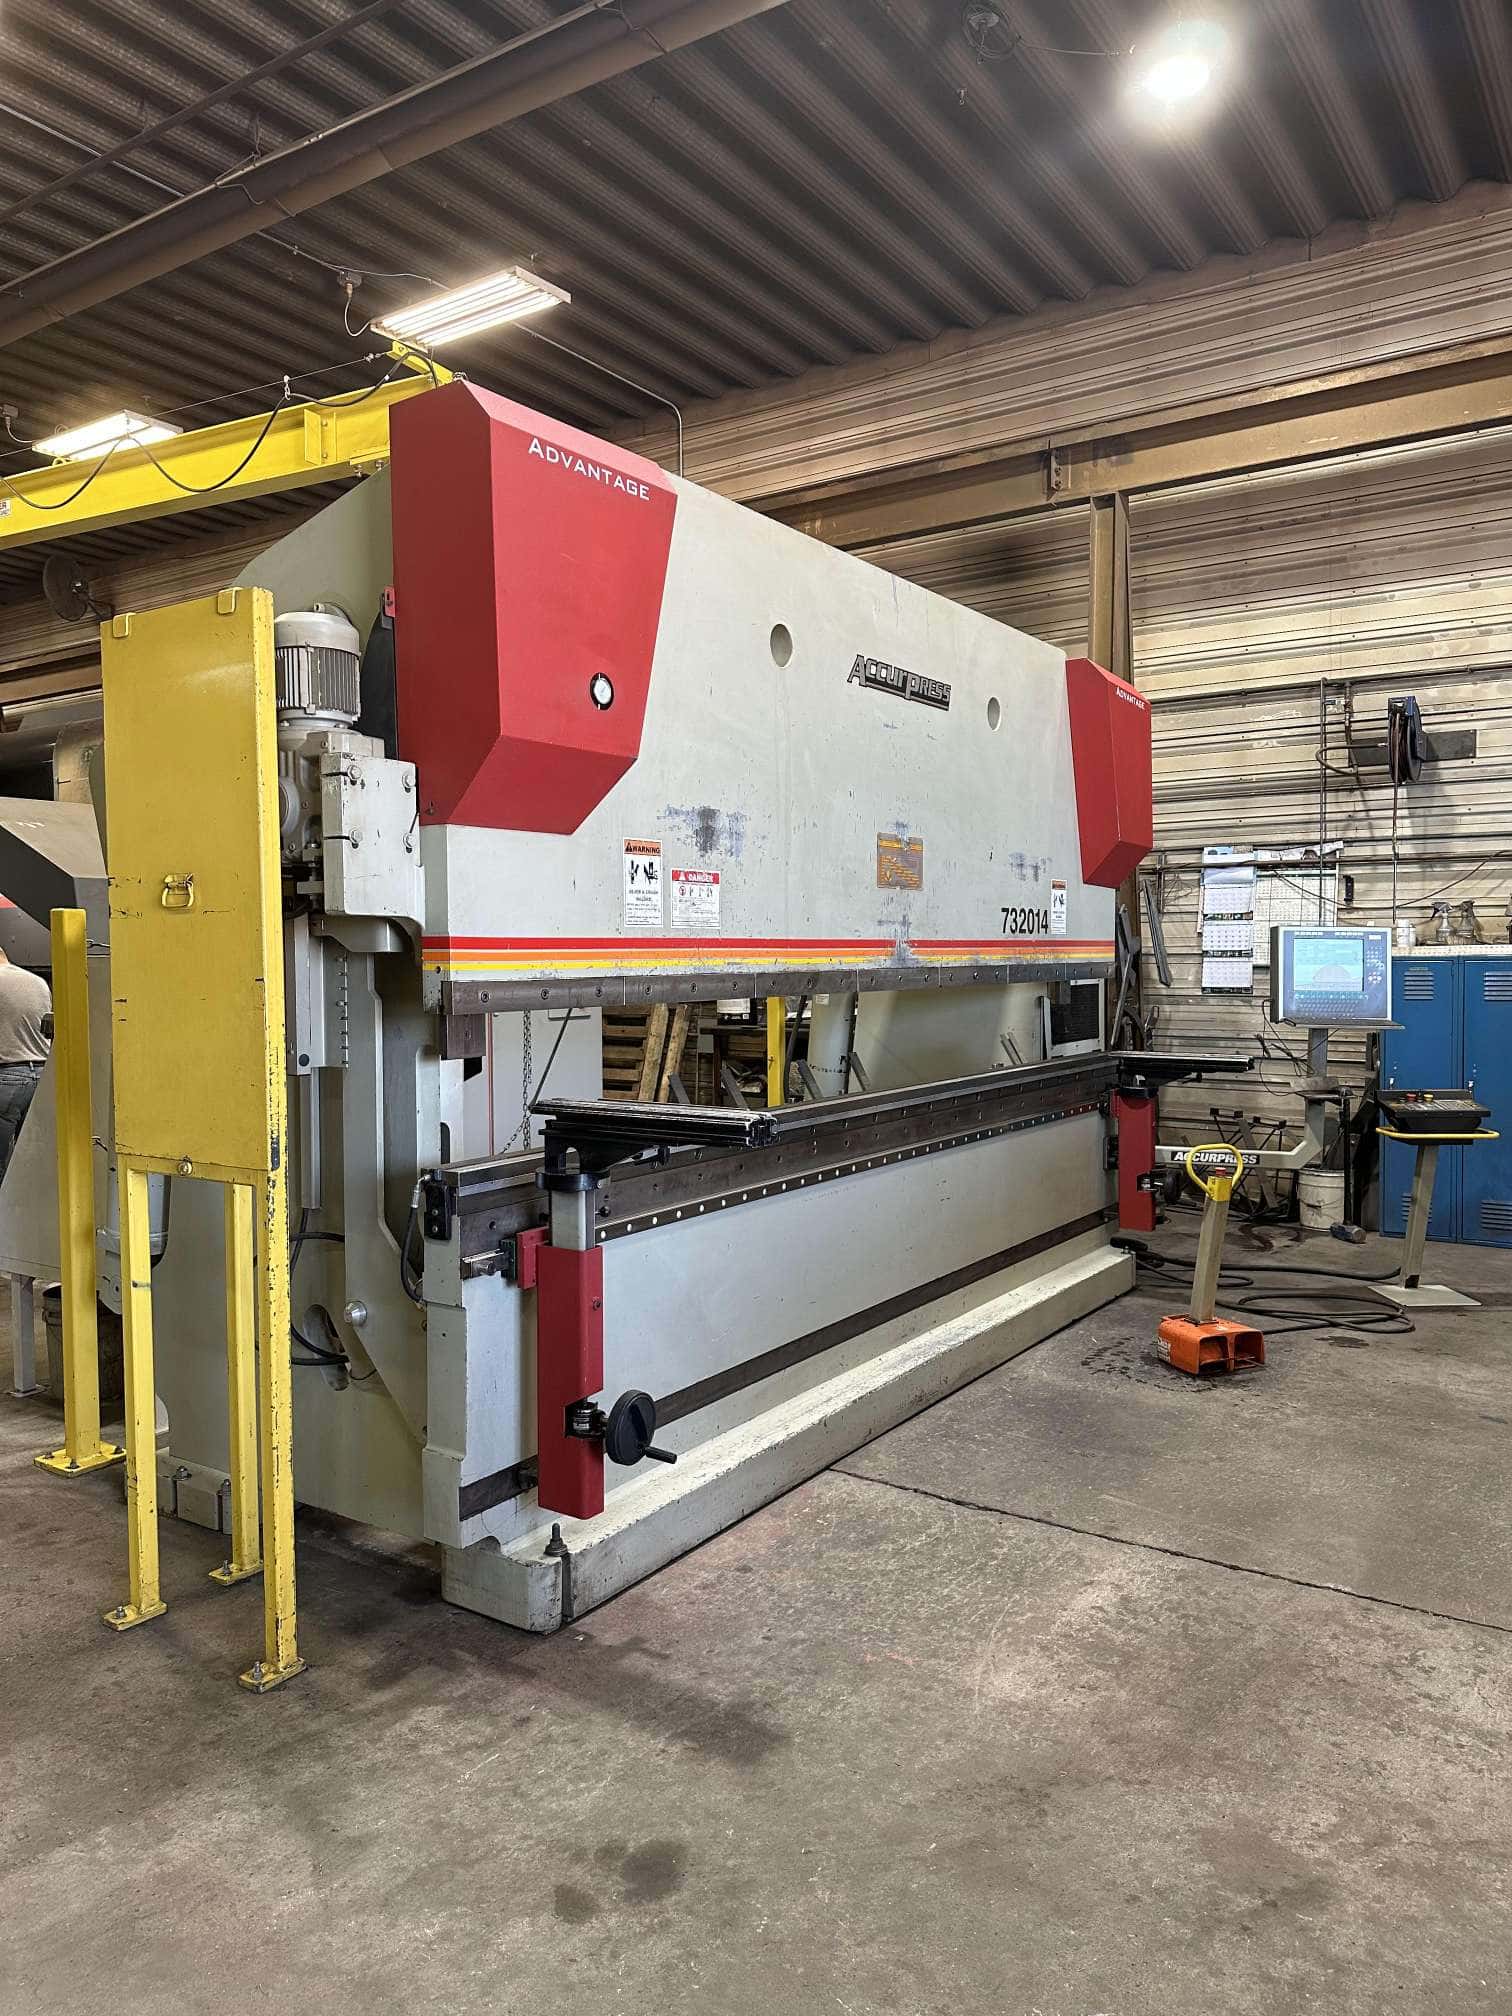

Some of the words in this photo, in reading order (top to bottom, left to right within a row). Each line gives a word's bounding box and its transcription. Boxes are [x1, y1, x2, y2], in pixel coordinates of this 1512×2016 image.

[528, 437, 650, 501] ADVANTAGE
[1116, 686, 1146, 710] ADVANTAGE
[632, 845, 661, 854] WARNING
[1001, 907, 1049, 935] 732014
